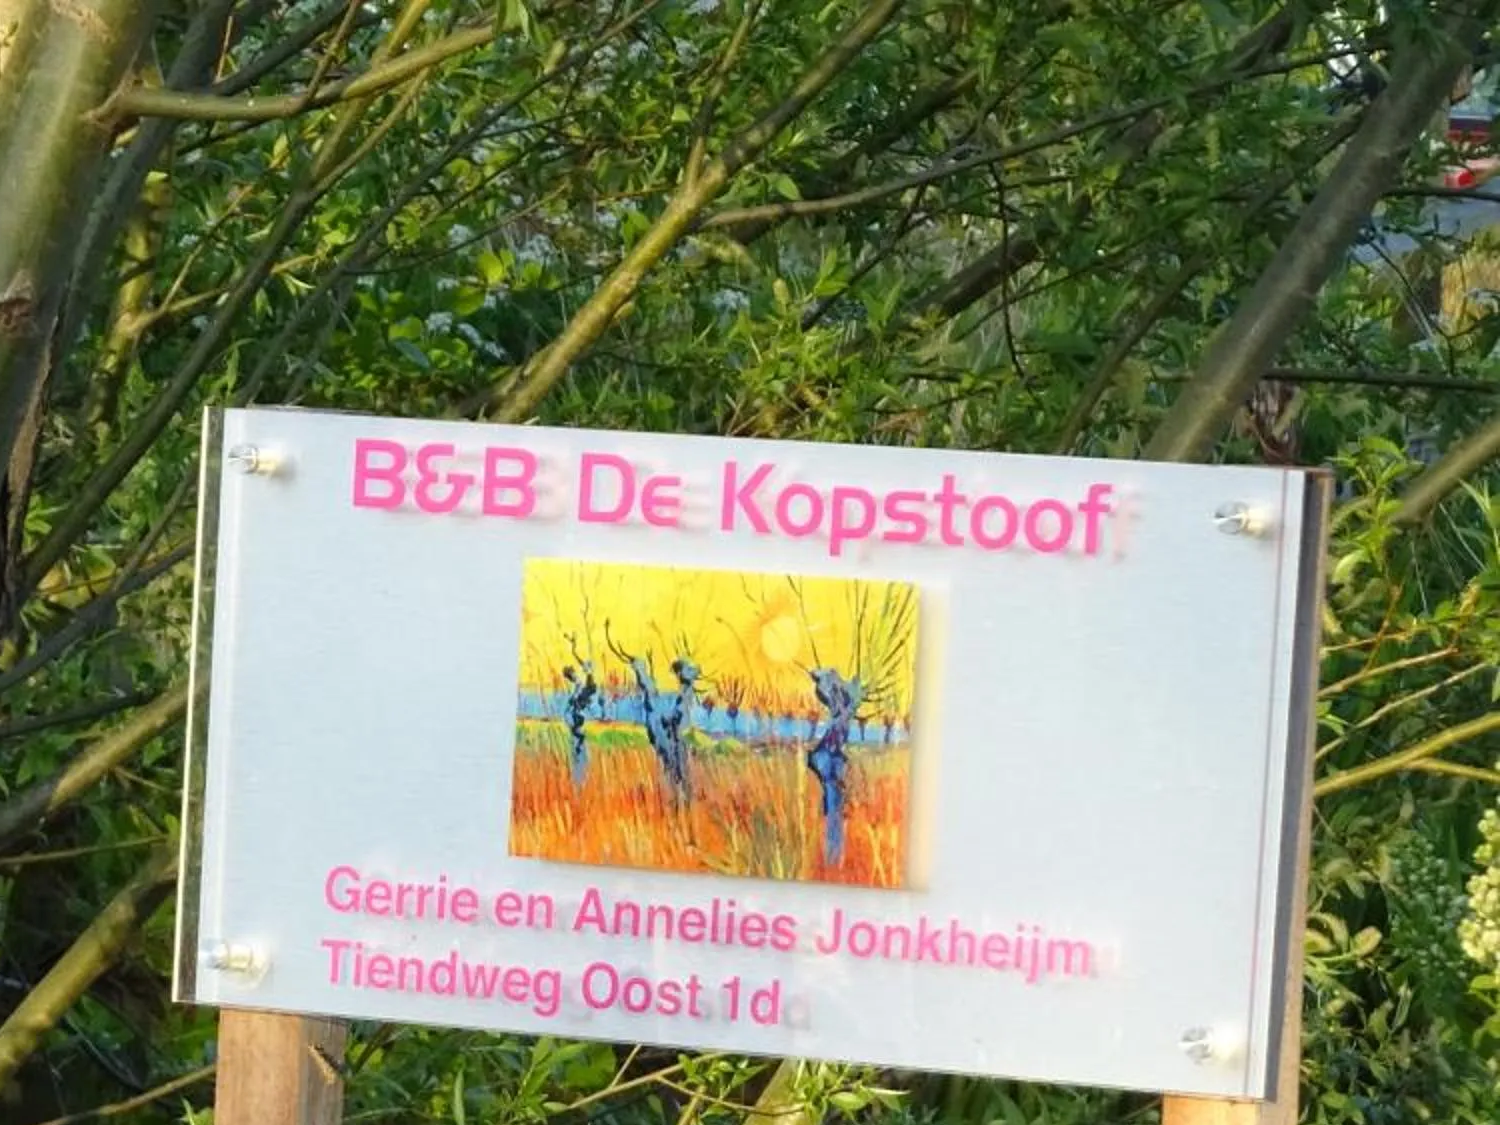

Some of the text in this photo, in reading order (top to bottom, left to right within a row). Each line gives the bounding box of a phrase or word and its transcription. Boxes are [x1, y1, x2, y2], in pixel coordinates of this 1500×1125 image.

[352, 438, 1115, 559] B&B De Kopstoof
[322, 939, 782, 1025] Tiendweg Oost 1d
[323, 864, 1092, 984] Gerrie en Annelies Jonkheijm
